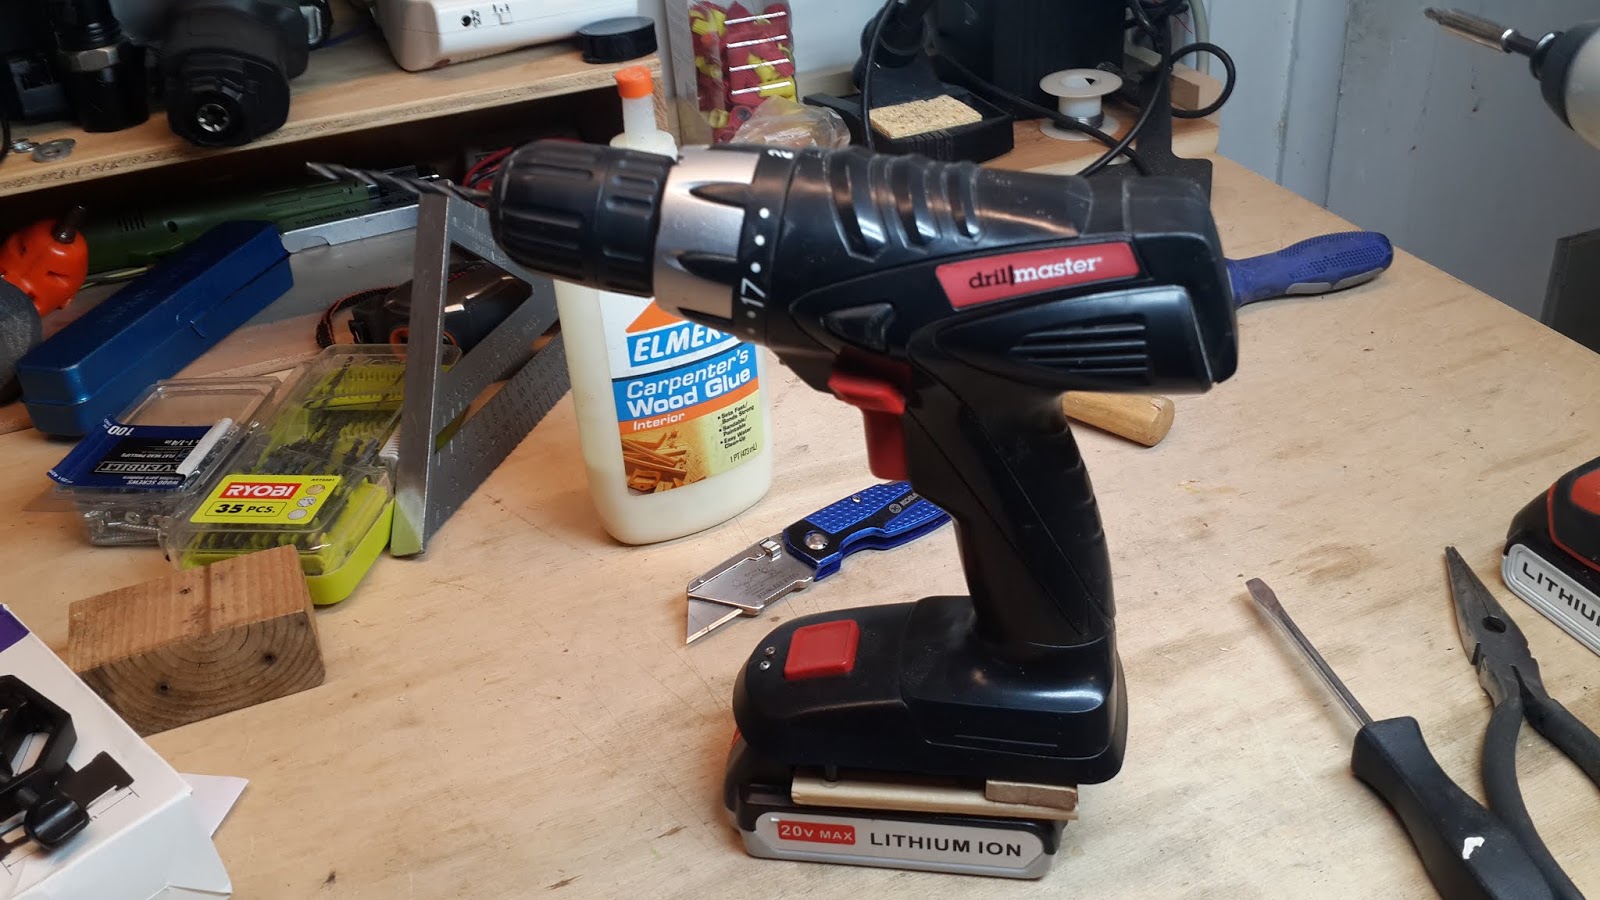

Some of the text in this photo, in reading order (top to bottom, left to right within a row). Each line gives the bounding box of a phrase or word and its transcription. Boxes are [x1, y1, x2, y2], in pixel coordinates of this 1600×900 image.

[741, 278, 766, 308] 17
[634, 323, 729, 362] ELMER
[627, 349, 749, 399] Carpenter's
[626, 368, 750, 418] Wood Glue
[739, 405, 754, 416] Strong
[633, 412, 685, 431] Interior
[723, 423, 746, 436] Paintable
[107, 425, 135, 436] 100
[724, 427, 752, 444] Easy Water
[733, 452, 740, 461] PT
[226, 485, 295, 497] RYOBI
[215, 503, 245, 513] 35
[1523, 562, 1600, 627] LITHIU
[781, 824, 852, 841] 20V MAX
[870, 832, 1021, 857] LITHIUM ION
